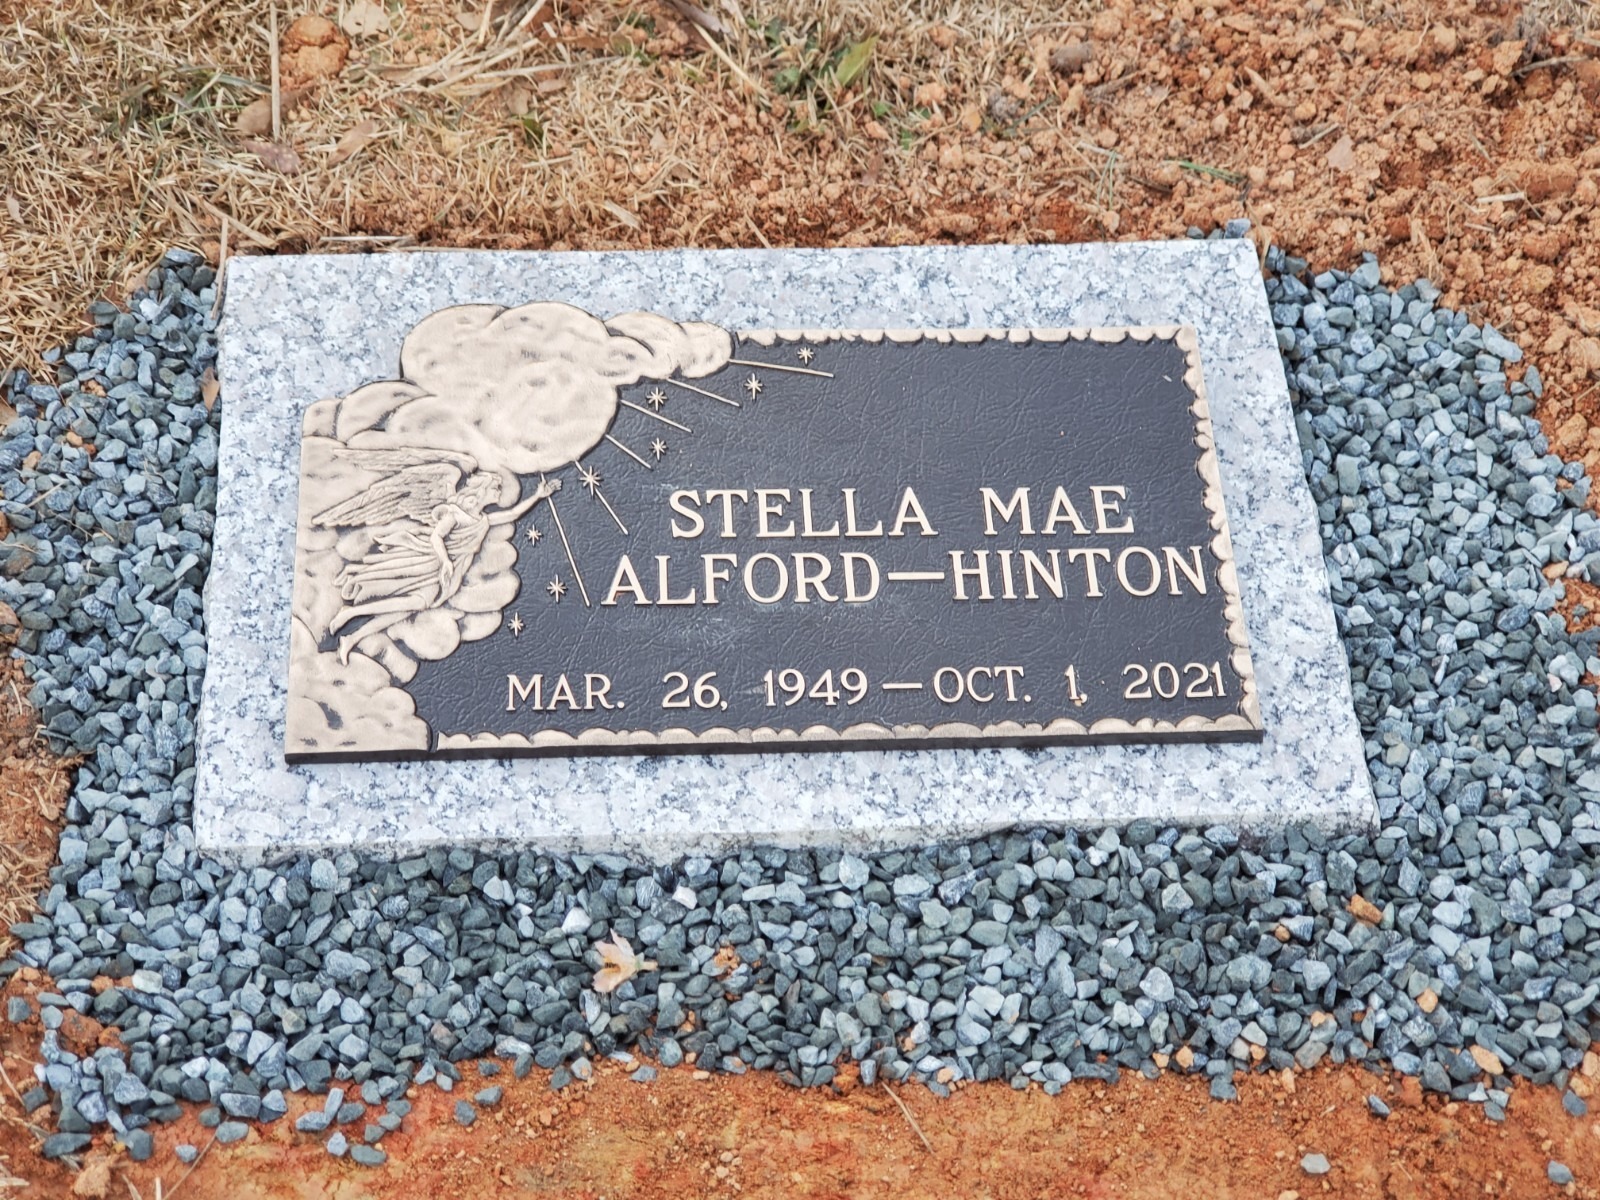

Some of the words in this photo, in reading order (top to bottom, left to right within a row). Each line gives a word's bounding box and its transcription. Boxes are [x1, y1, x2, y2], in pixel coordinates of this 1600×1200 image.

[669, 486, 939, 539] STELLA
[978, 483, 1136, 537] MAE
[506, 672, 626, 713] MAR.
[661, 670, 729, 711] 26,
[1121, 660, 1227, 701] 2021
